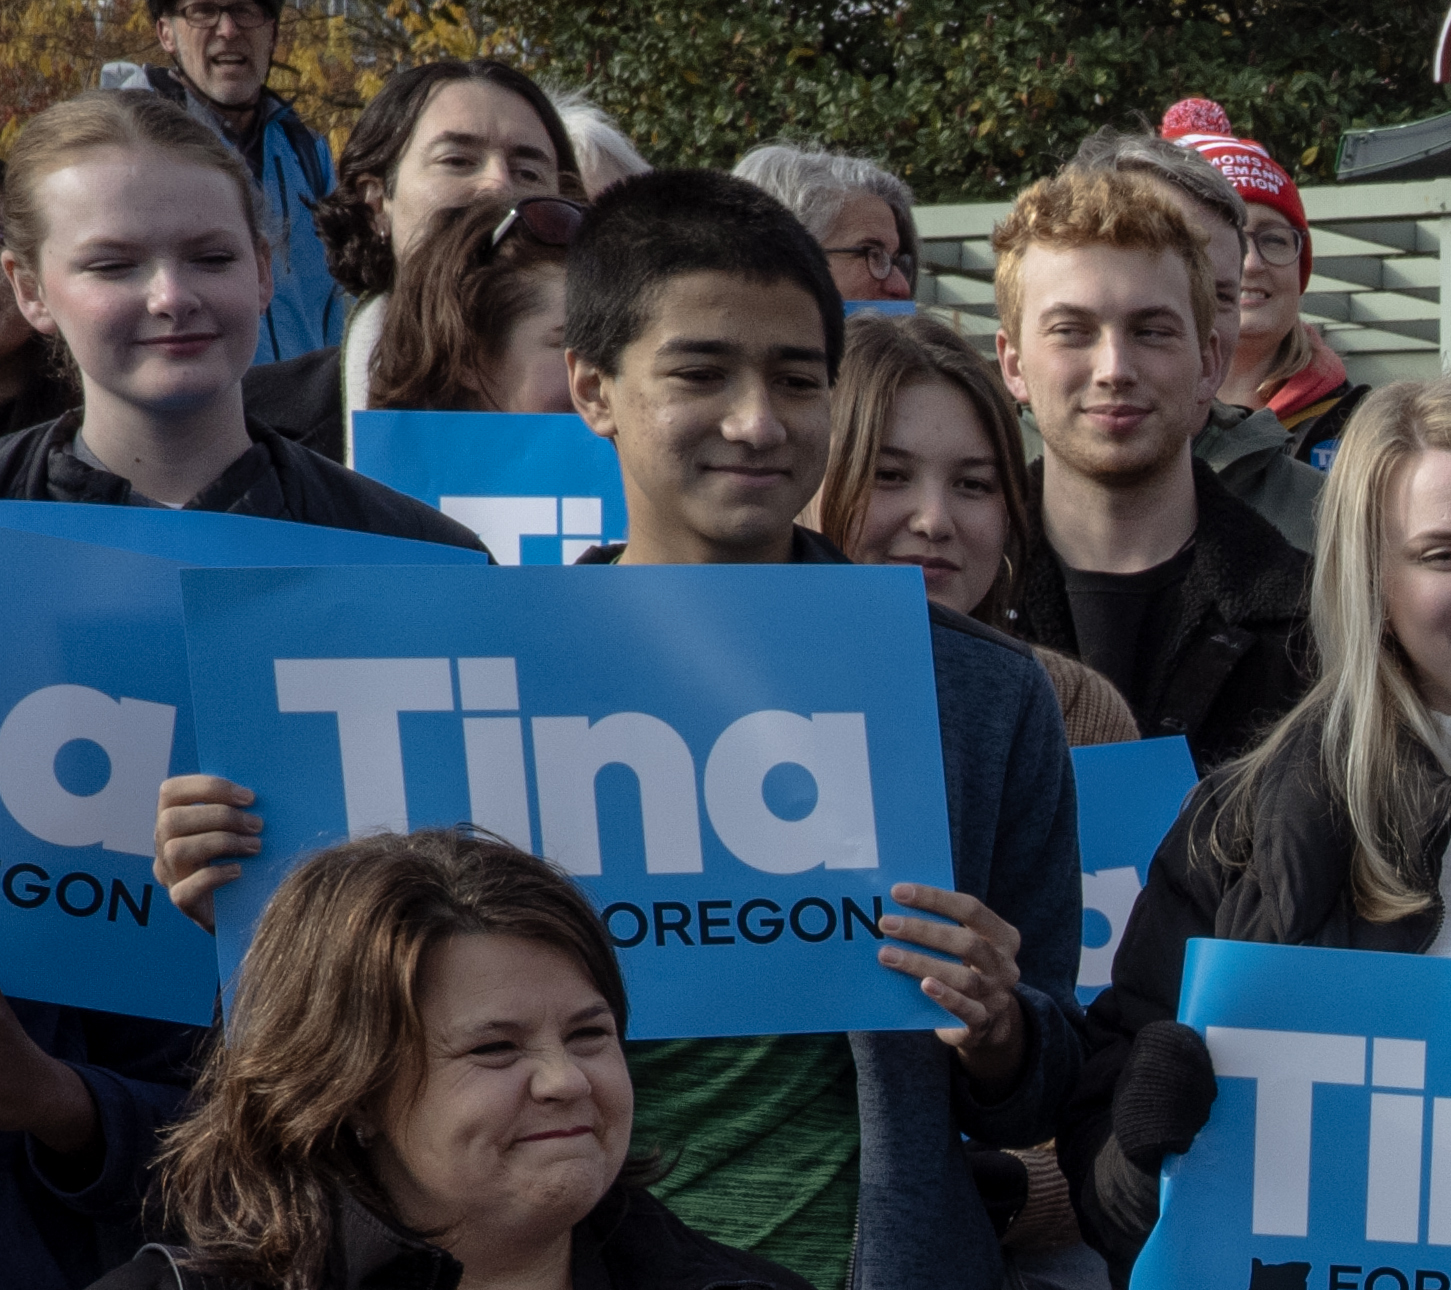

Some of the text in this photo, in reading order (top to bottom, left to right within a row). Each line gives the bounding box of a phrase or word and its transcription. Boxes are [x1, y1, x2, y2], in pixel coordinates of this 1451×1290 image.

[1211, 154, 1262, 168] MOMS
[1221, 165, 1284, 187] EMAND
[1228, 176, 1279, 195] CTION
[276, 656, 878, 877] Tina
[2, 862, 153, 928] GON
[607, 896, 886, 948] OREGON
